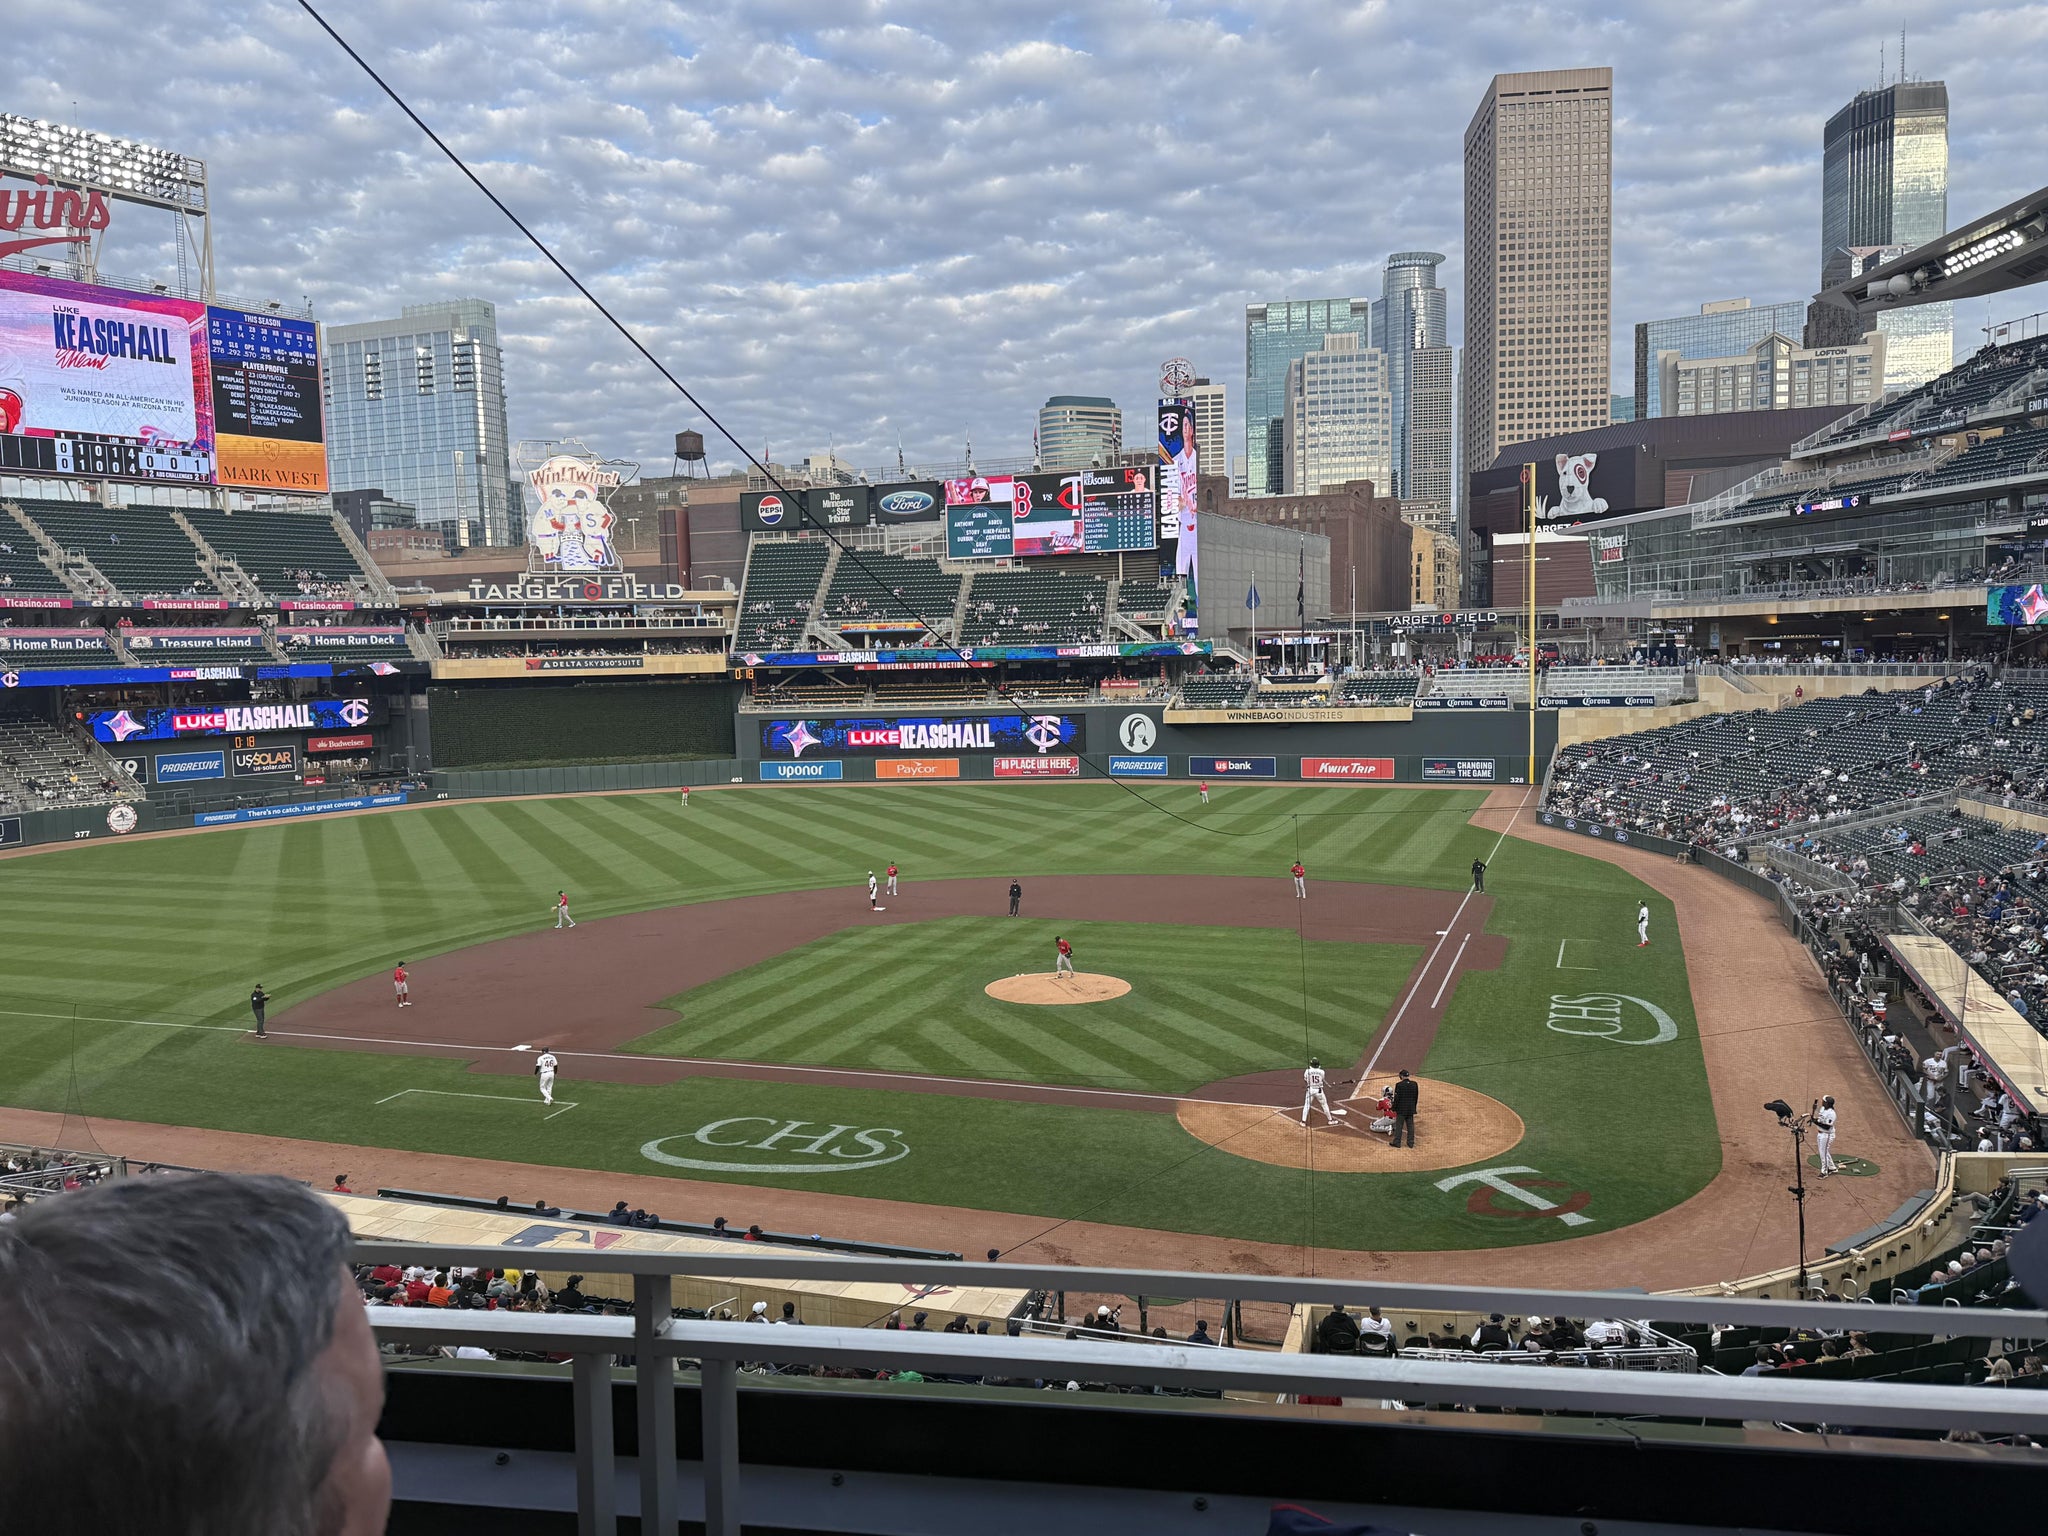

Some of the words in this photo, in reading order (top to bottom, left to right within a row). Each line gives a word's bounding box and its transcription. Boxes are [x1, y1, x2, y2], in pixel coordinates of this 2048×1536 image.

[53, 305, 79, 314] LUKE
[244, 314, 257, 323] THIS
[258, 316, 280, 327] SEASON
[54, 312, 176, 364] KEASCHALL
[243, 361, 264, 371] PLAYER
[265, 364, 288, 374] PROFILE
[61, 387, 76, 395] WAS
[78, 389, 102, 398] NAMED
[116, 393, 165, 405] ALL-AMERICAN
[64, 395, 90, 404] JUNIOR
[92, 397, 120, 406] SEASON
[132, 402, 162, 411] ARIZONA
[2029, 400, 2041, 411] END
[61, 443, 67, 454] 0
[78, 444, 84, 455] 1
[95, 445, 102, 456] 0
[112, 447, 117, 457] 1
[128, 448, 135, 460] 4
[62, 457, 68, 468] 0
[80, 459, 85, 470] 1
[96, 461, 103, 472] 0
[113, 462, 119, 473] 0
[129, 463, 136, 474] 4
[147, 455, 153, 467] 0
[171, 458, 177, 469] 0
[195, 459, 199, 471] 1
[224, 466, 271, 481] MARK
[276, 470, 319, 485] WEST
[532, 467, 565, 484] Win!
[568, 466, 618, 485] Twins!
[1084, 476, 1114, 485] KEASCHALL
[830, 492, 841, 500] The
[823, 499, 854, 508] Minnesota
[891, 495, 922, 510] Ford
[544, 509, 553, 518] M
[760, 506, 782, 514] PEPSI
[837, 507, 850, 515] Star
[586, 513, 596, 527] S
[828, 514, 850, 523] Tribune
[469, 584, 579, 600] TARGET
[608, 584, 684, 599] FIELD
[153, 601, 191, 609] Treasure
[194, 601, 220, 609] Island
[1385, 615, 1438, 625] TARGET
[1456, 613, 1497, 622] FIELD
[13, 639, 47, 650] Home
[51, 639, 73, 649] Run
[76, 638, 102, 649] Deck
[159, 638, 214, 647] Treasure
[217, 637, 251, 647] Island
[315, 636, 345, 646] Home
[348, 636, 368, 645] Run
[371, 636, 395, 645] Deck
[839, 652, 878, 662] KEASCHALL
[1079, 646, 1120, 657] KEASCHALL
[553, 660, 581, 668] DELTA
[196, 667, 241, 680] KEASCHALL
[1447, 698, 1473, 706] Corona
[1480, 698, 1506, 706] Corona
[1541, 697, 1568, 705] Corona
[1582, 697, 1610, 705] Corona
[1625, 696, 1653, 705] Corona
[176, 715, 225, 729] LUKE
[225, 705, 313, 731] KEASCHALL
[1227, 712, 1283, 720] WINNEBAGO
[1283, 711, 1342, 719] INDUSTRIES
[851, 731, 899, 743] LUKE
[900, 724, 995, 749] KEASCHALL
[161, 760, 221, 772] PROGRESSIVE
[253, 764, 293, 772] us-solar.com
[1010, 760, 1036, 769] PLACE
[1037, 759, 1049, 768] LIKE
[1050, 759, 1071, 768] HERE
[1113, 762, 1164, 770] PROGRESSIVE
[778, 765, 823, 778] uponor
[897, 765, 937, 775] Paycor
[248, 808, 271, 817] There's
[282, 806, 300, 814] catch.
[302, 804, 316, 812] Just
[317, 804, 332, 812] great
[334, 801, 363, 810] coverage.
[1547, 995, 1622, 1036] CHS
[694, 1117, 903, 1158] CHS
